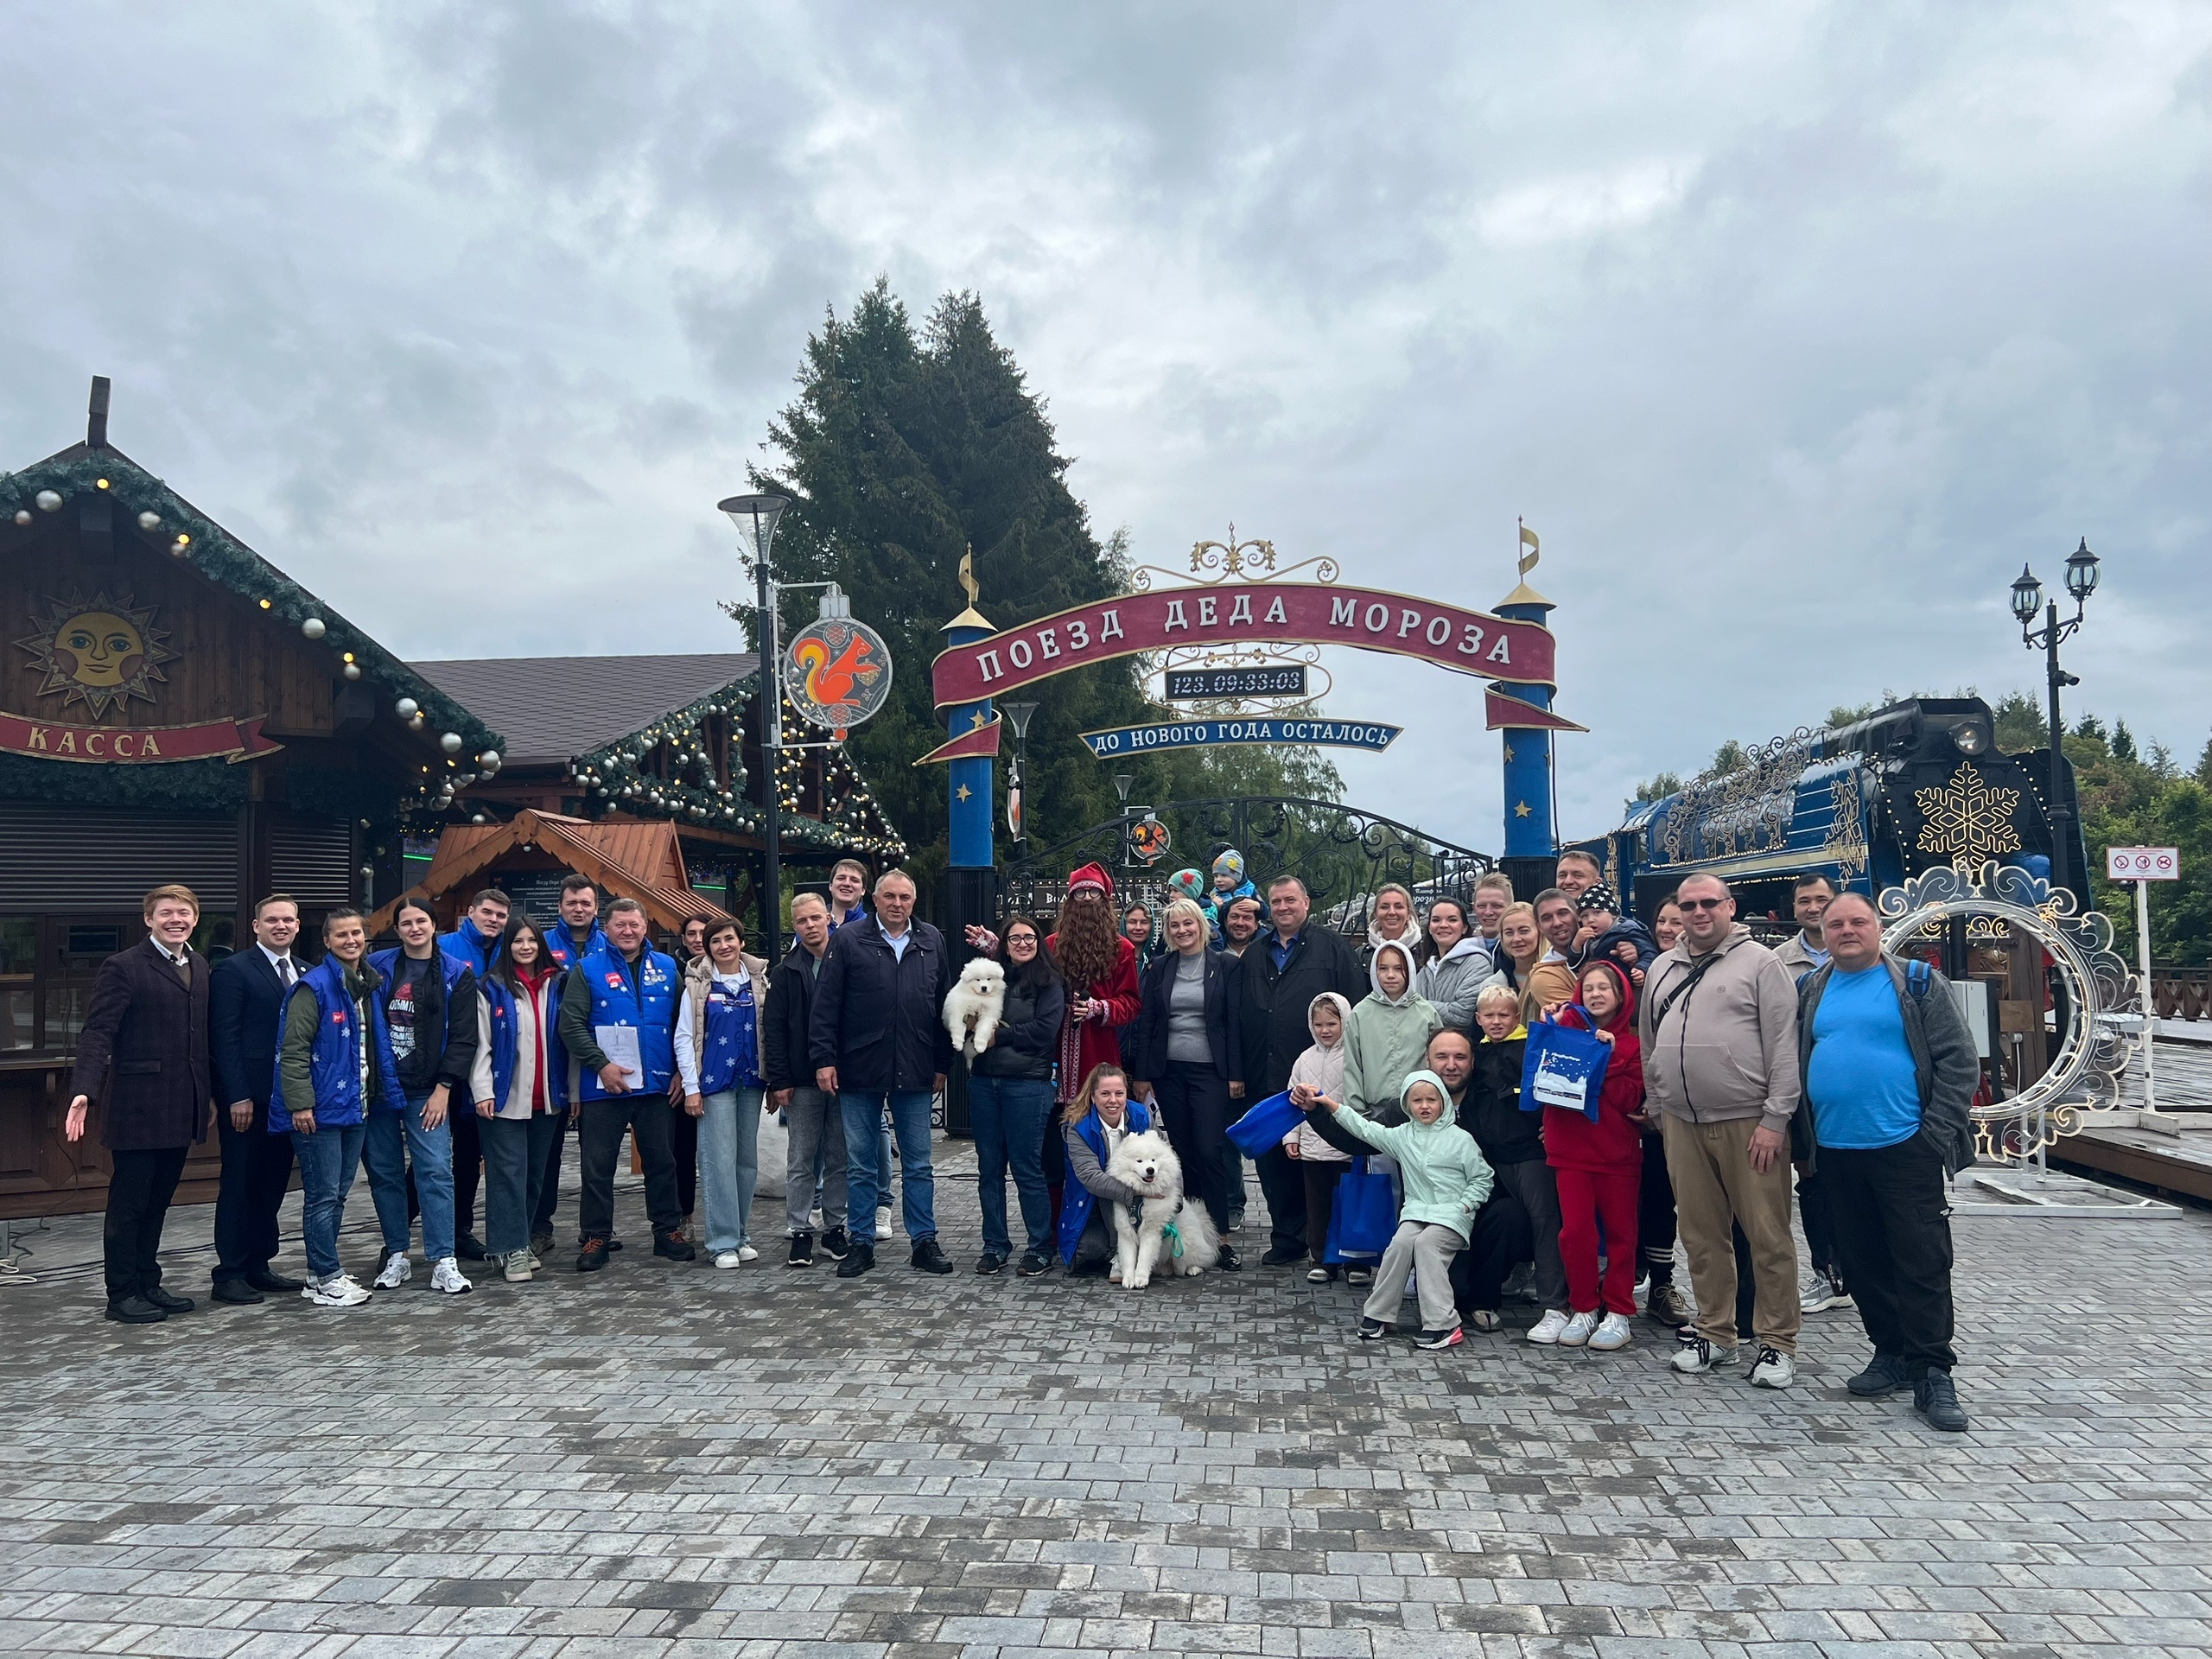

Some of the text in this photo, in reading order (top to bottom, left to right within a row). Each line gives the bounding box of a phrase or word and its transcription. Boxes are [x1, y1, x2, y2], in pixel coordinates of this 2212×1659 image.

[976, 594, 1511, 683] ПОЕЗД ДЕДА МОРОЗА
[27, 726, 162, 758] КАССА
[1094, 722, 1389, 753] ДО НОВОГО ГОДА ОСТАЛОСЬ
